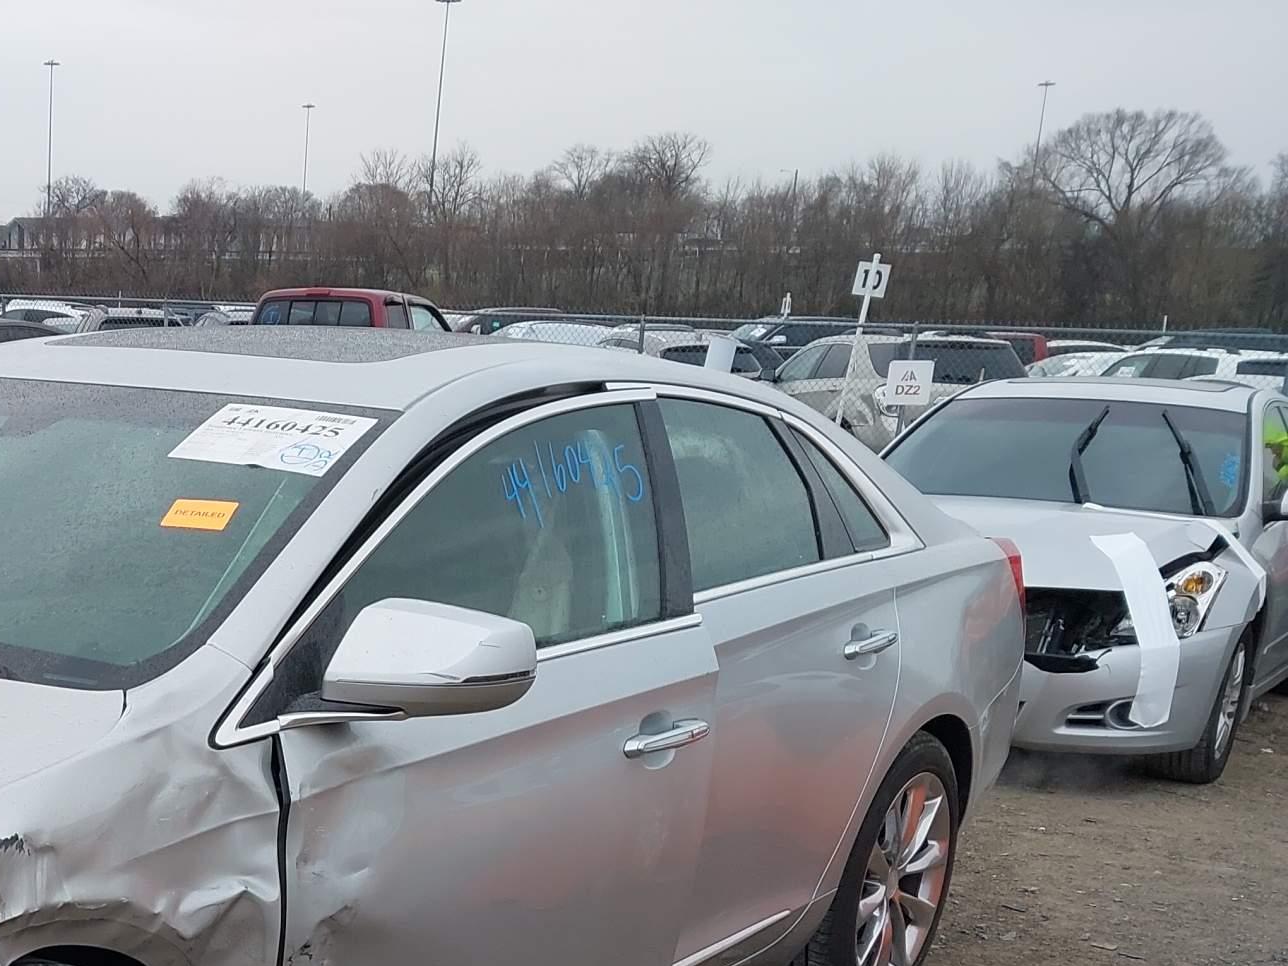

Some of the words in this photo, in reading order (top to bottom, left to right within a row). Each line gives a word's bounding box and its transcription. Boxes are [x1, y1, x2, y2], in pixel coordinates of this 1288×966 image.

[895, 384, 921, 396] DZ2
[223, 415, 345, 438] 44160425
[174, 509, 226, 519] DETAILED
